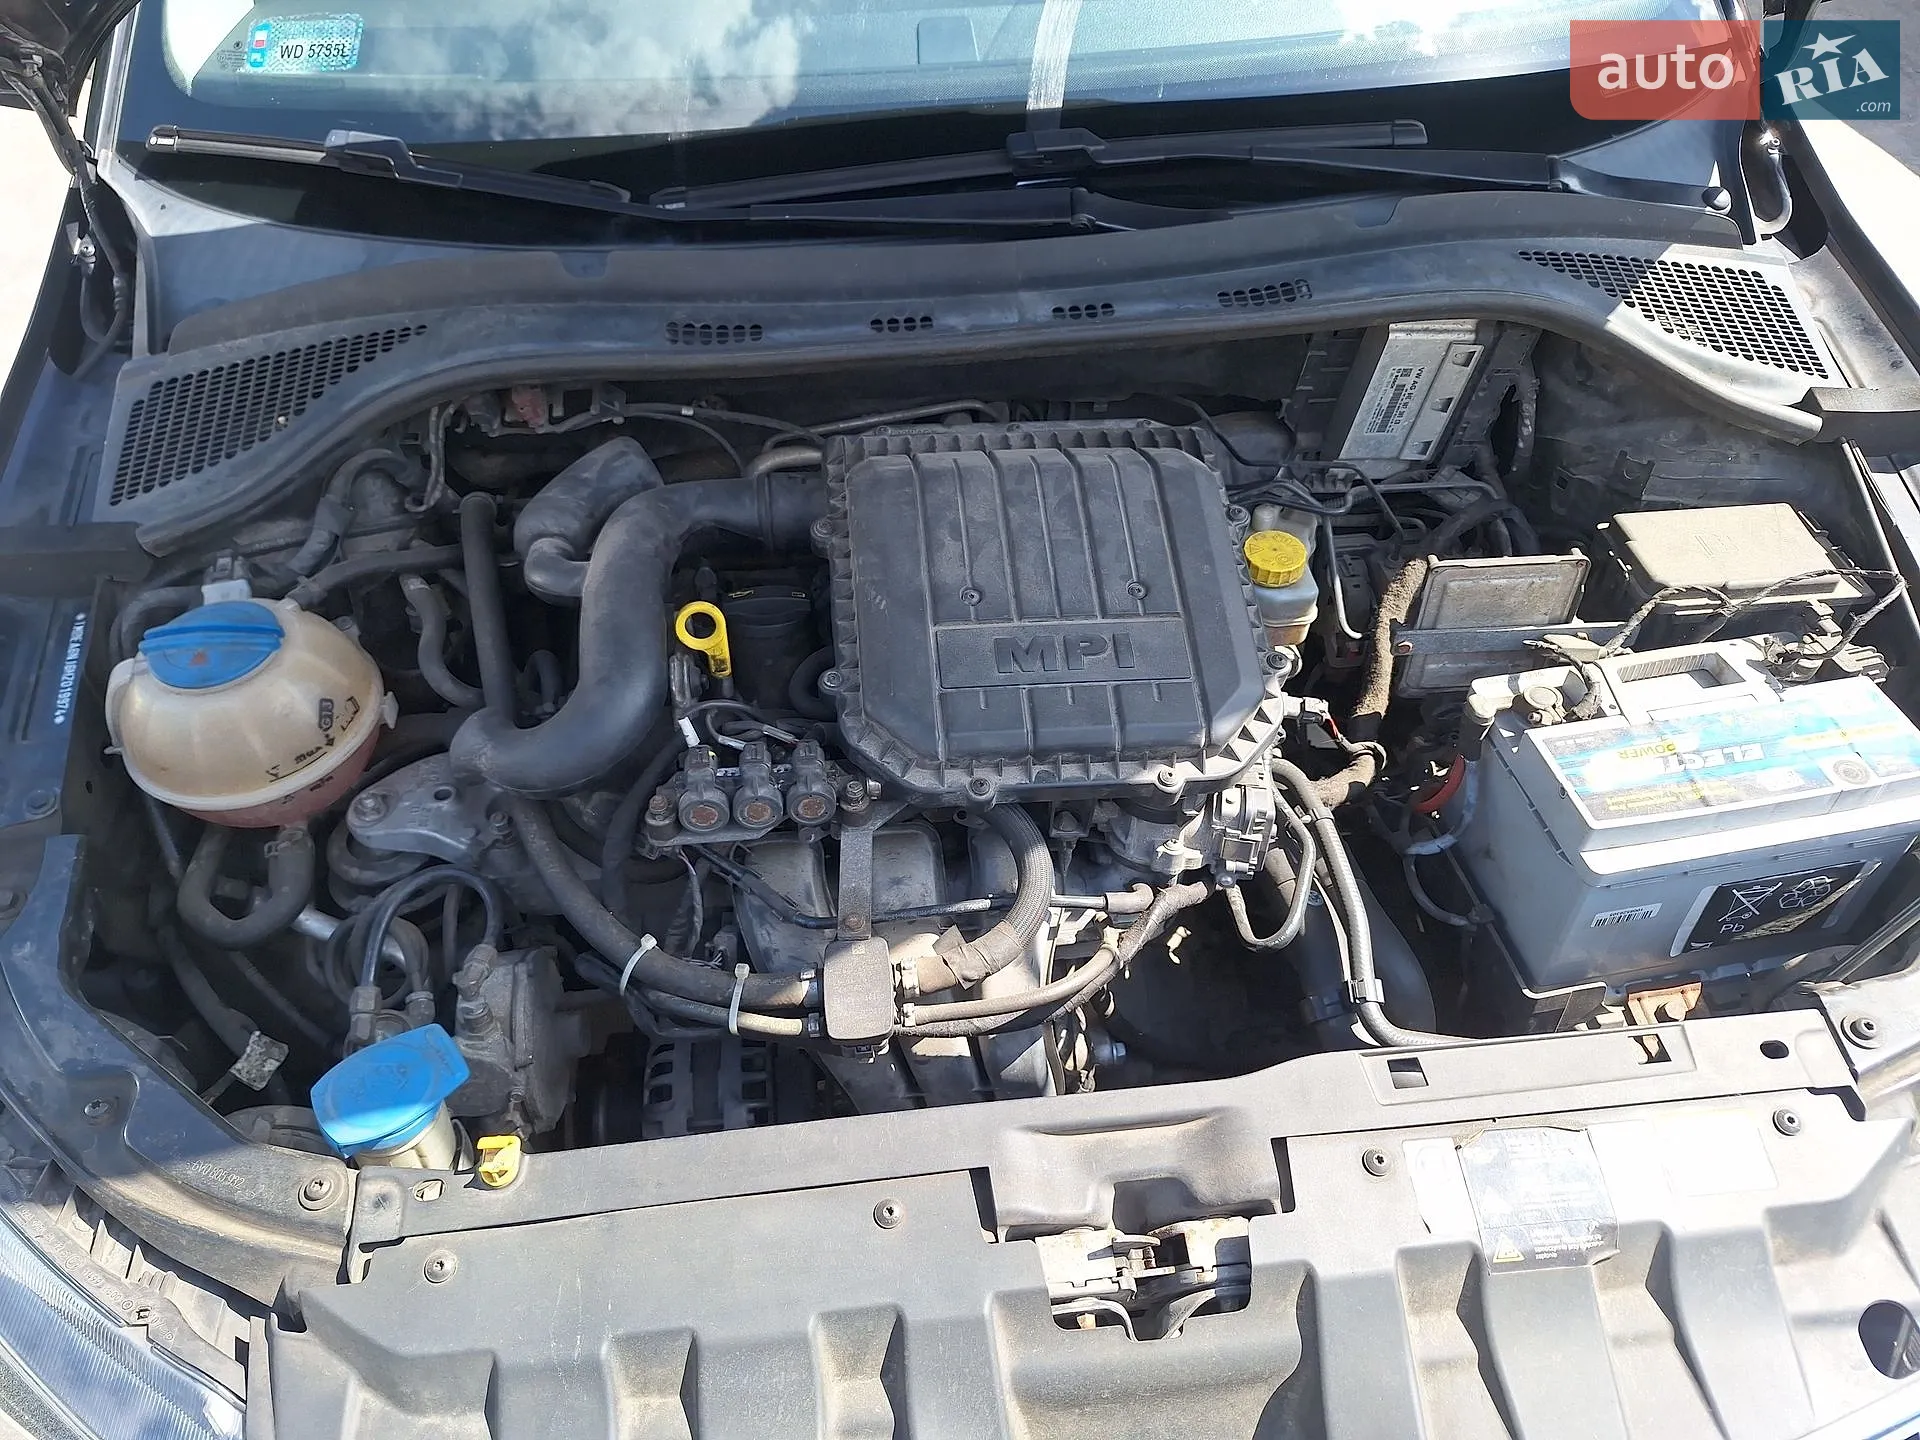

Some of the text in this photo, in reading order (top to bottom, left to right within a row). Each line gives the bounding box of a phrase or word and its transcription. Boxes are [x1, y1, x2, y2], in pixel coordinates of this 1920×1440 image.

[280, 44, 304, 59] WD
[993, 632, 1135, 674] MPI
[1719, 922, 1745, 934] Pb
